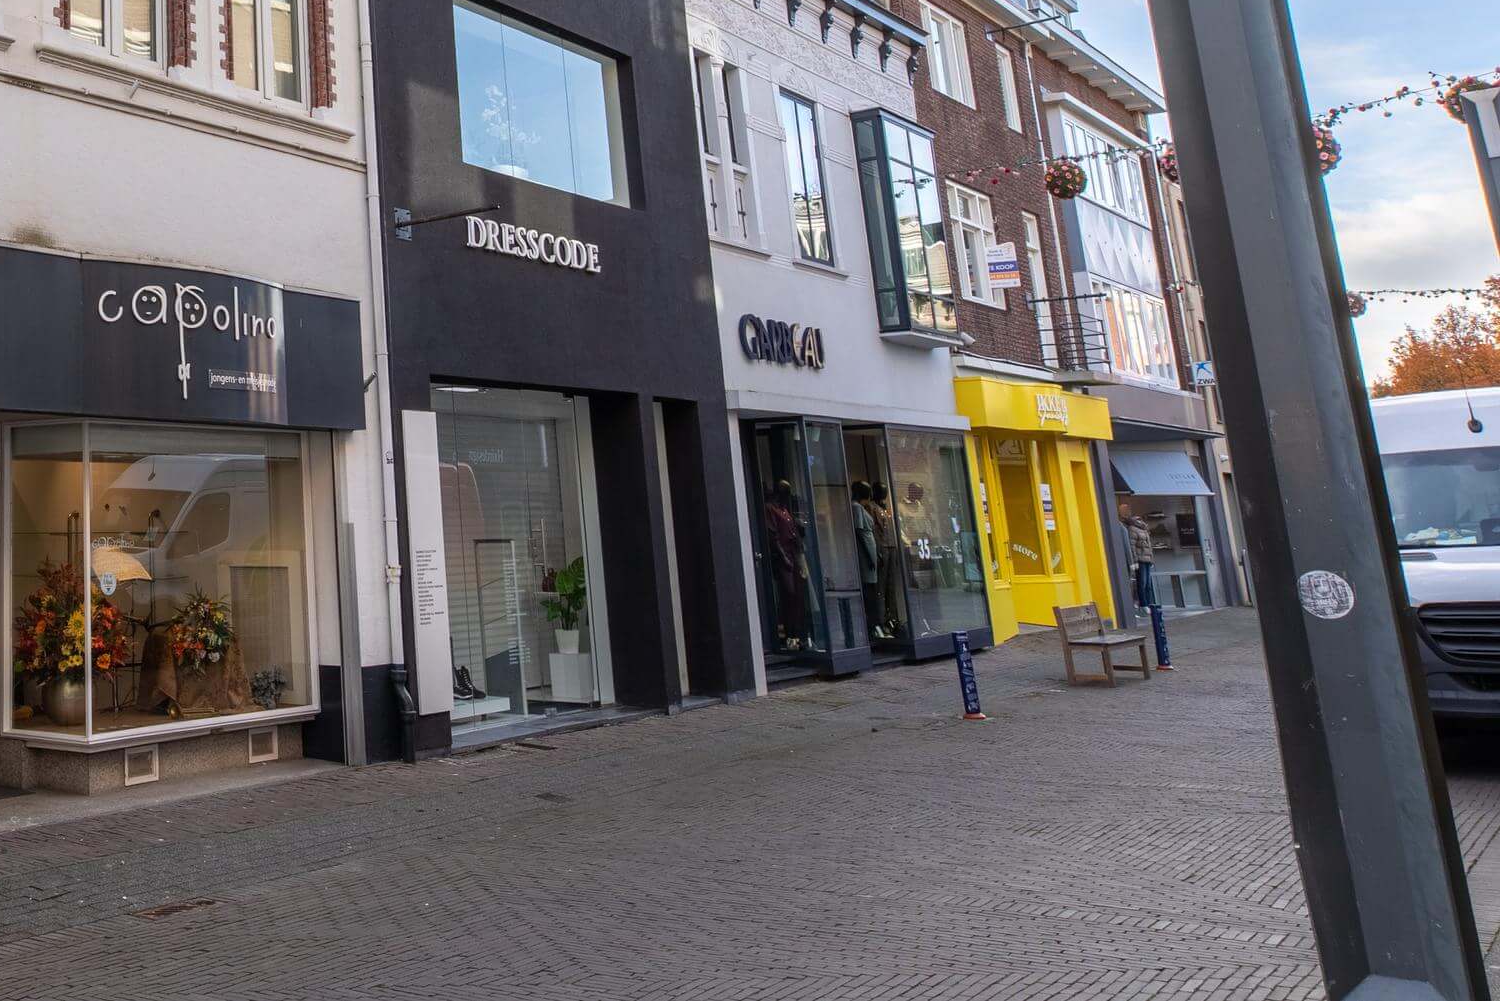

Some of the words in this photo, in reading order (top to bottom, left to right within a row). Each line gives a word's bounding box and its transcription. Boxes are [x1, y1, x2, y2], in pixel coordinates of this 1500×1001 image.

[465, 215, 602, 273] DRESSCODE
[917, 538, 931, 560] 35
[1012, 543, 1038, 560] store
